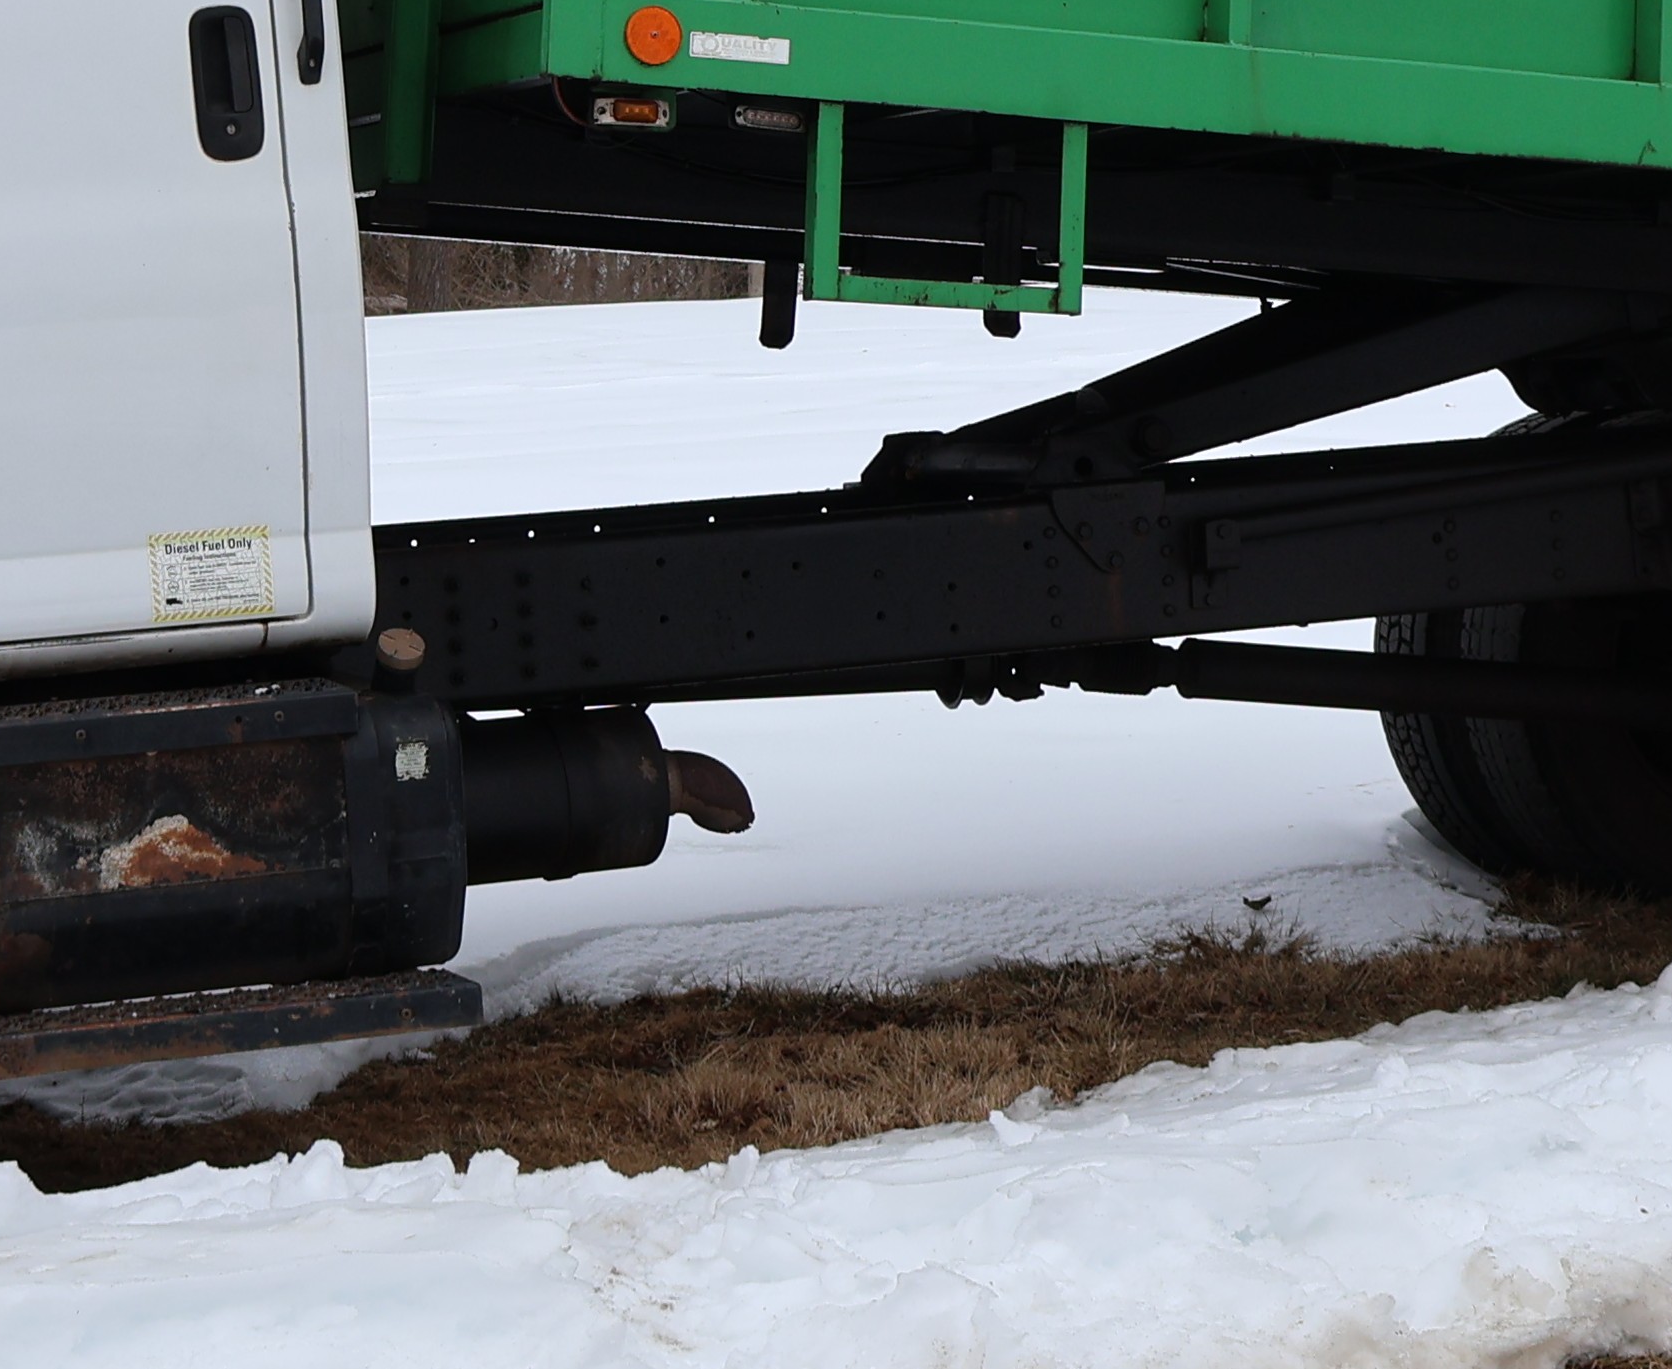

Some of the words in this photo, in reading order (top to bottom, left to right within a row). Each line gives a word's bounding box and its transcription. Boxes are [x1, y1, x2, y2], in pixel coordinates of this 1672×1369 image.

[164, 541, 199, 555] Diesel
[202, 539, 225, 551] Fuel
[228, 537, 252, 550] Only
